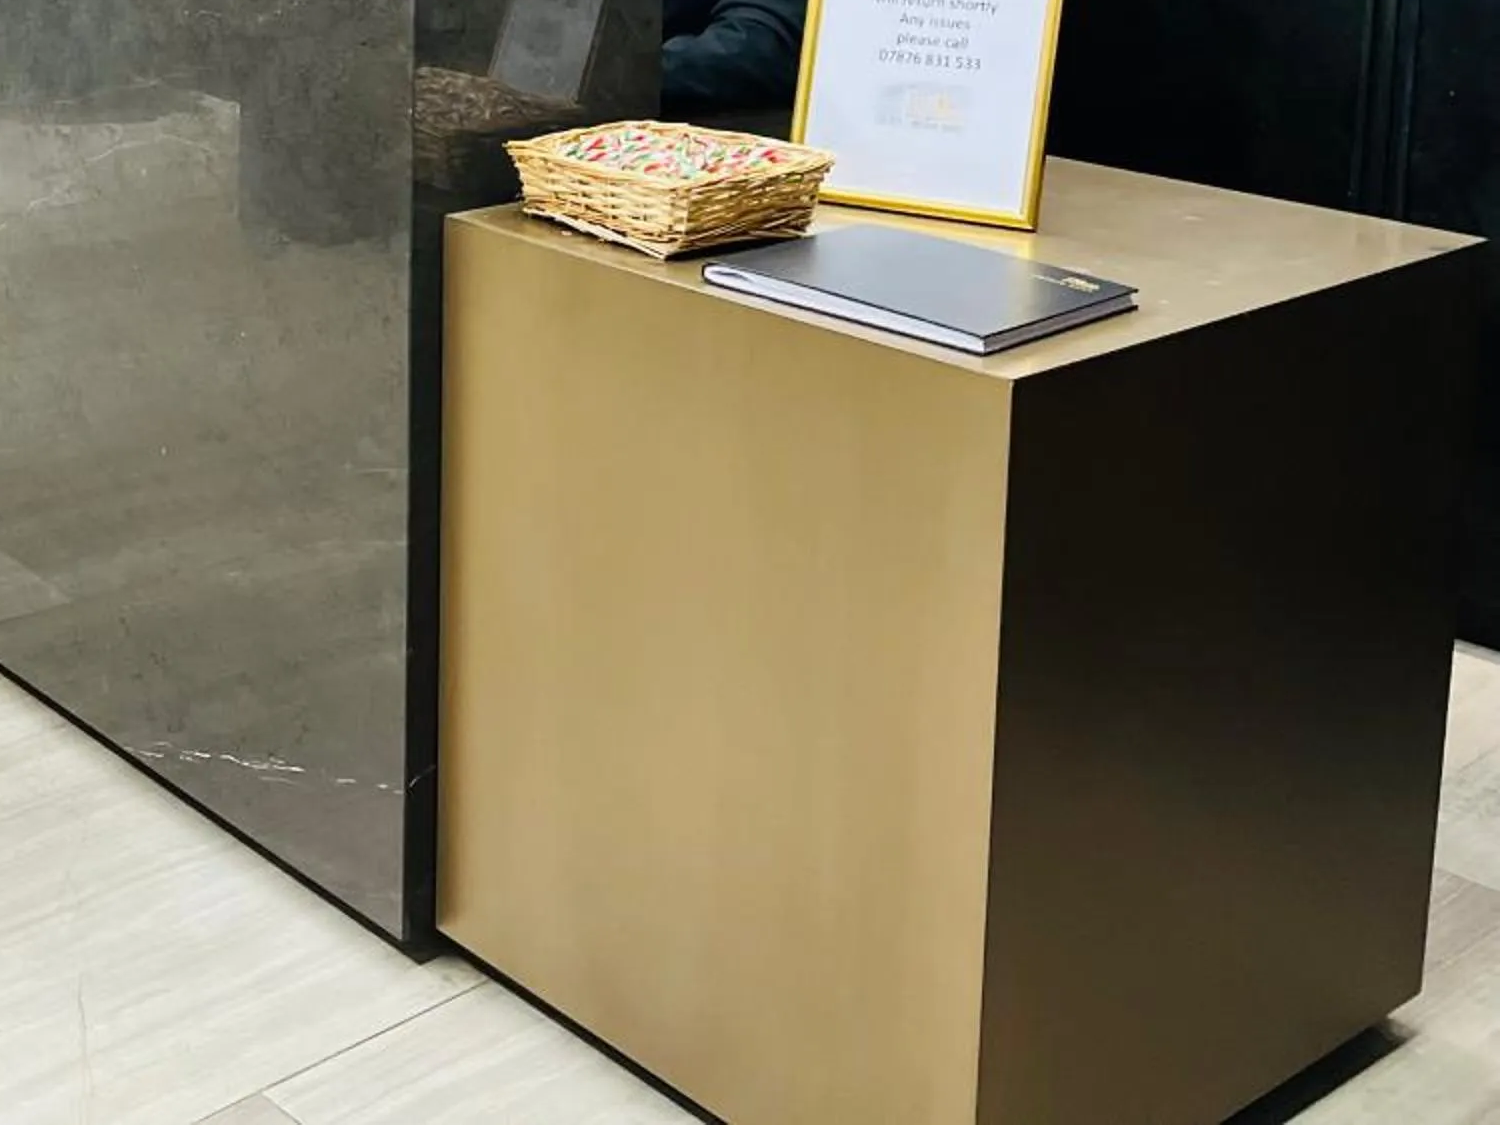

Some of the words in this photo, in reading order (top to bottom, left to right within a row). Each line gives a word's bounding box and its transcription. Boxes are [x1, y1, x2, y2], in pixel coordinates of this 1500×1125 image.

[899, 12, 924, 28] Any
[929, 17, 971, 31] issues
[896, 32, 941, 46] please
[945, 36, 969, 49] call
